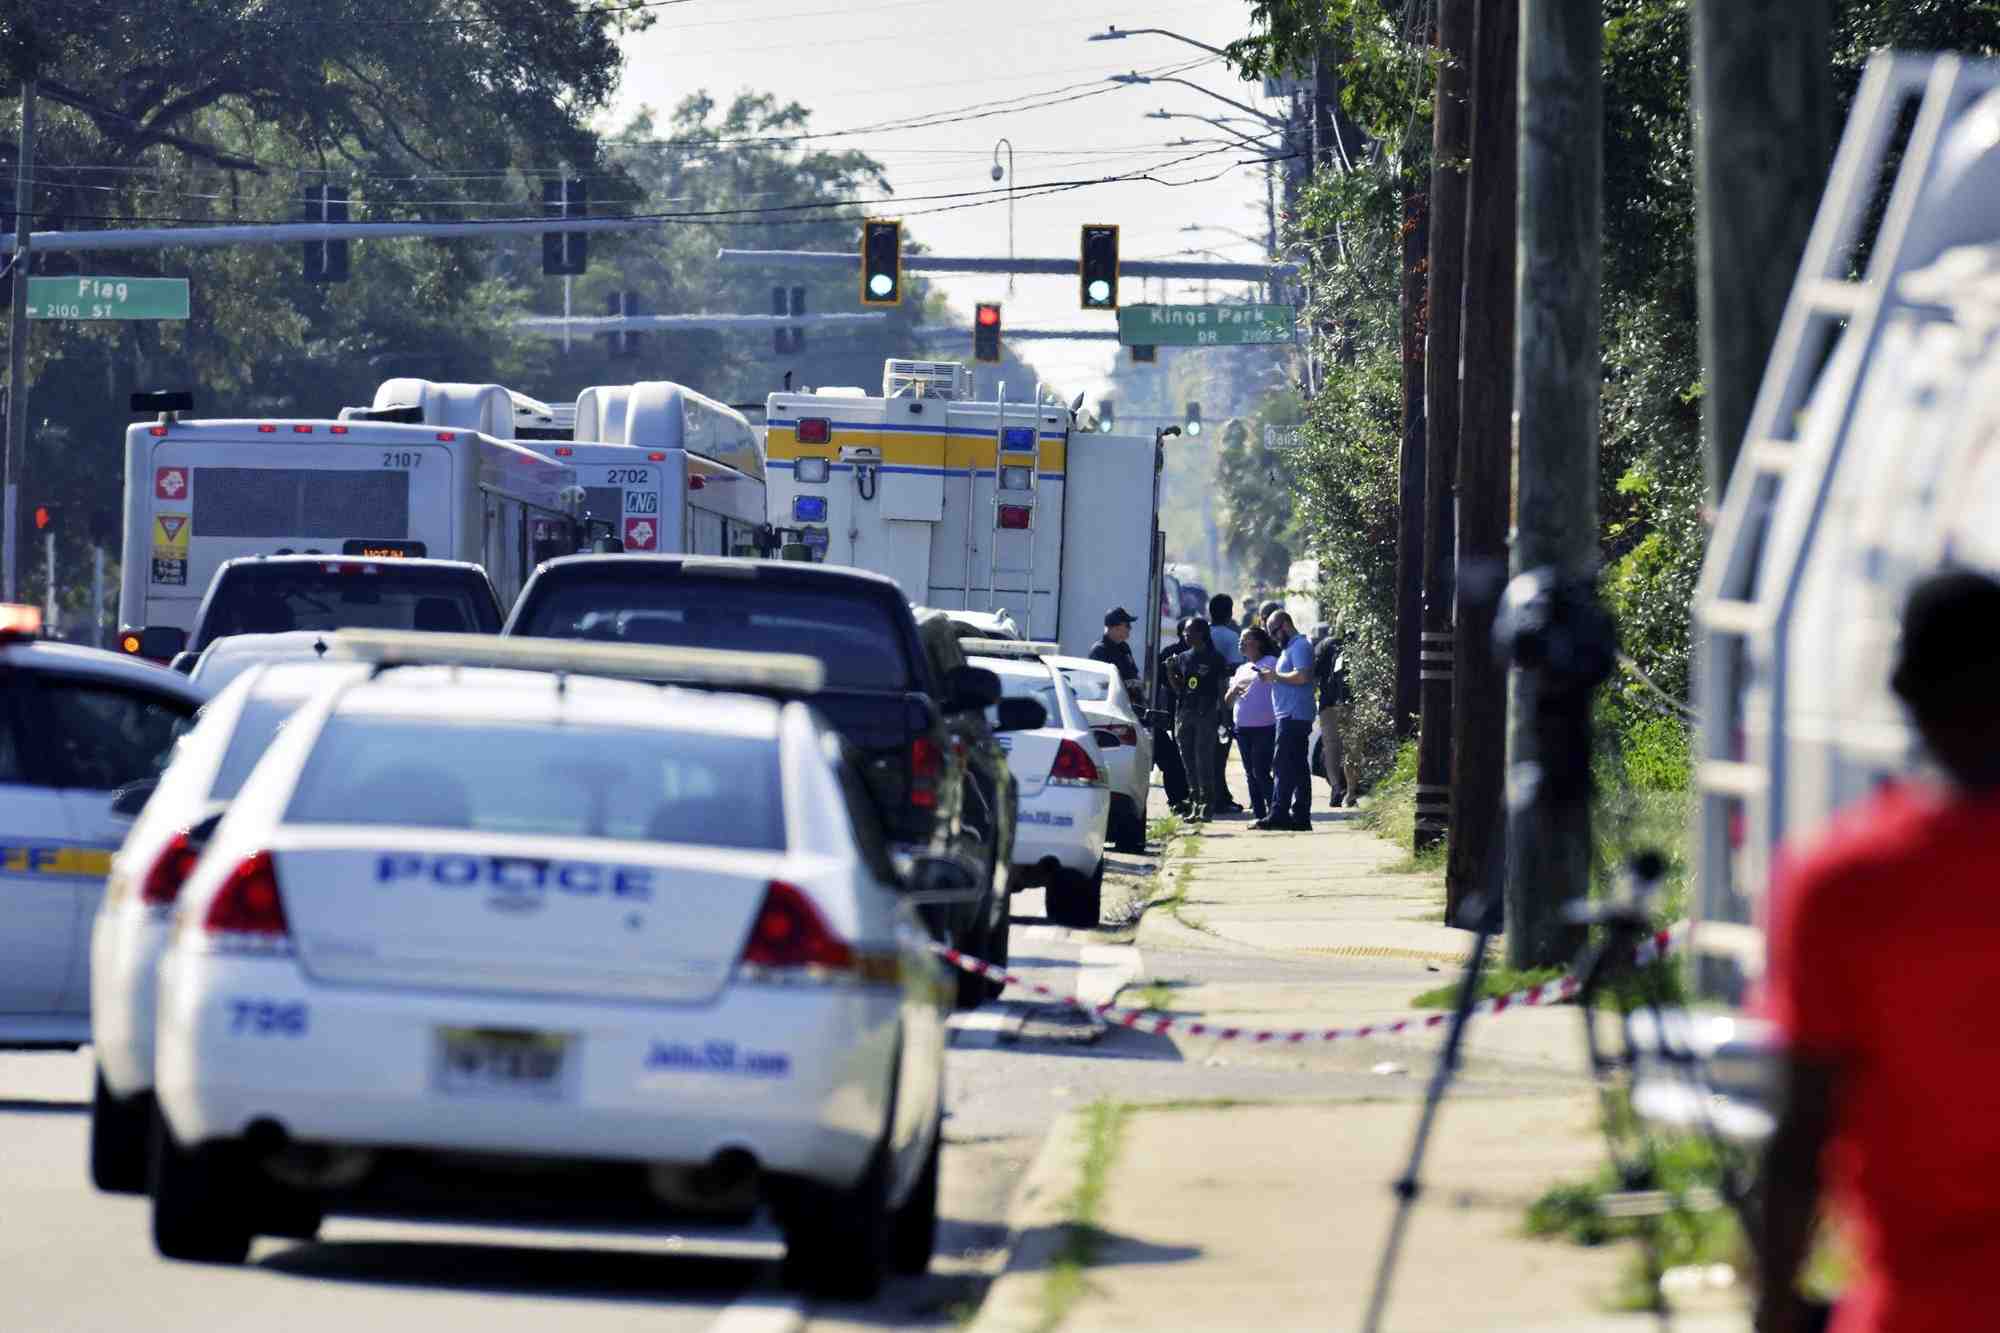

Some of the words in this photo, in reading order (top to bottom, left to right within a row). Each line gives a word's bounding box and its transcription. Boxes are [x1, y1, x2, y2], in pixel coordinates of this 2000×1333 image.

[78, 280, 129, 303] Flag
[47, 303, 80, 318] 2100
[92, 304, 113, 318] ST
[1151, 308, 1208, 327] Kings
[1217, 308, 1264, 324] Park
[1197, 330, 1217, 344] DR
[383, 451, 423, 468] 2107
[607, 470, 648, 484] 2702
[626, 491, 657, 512] CNG
[375, 853, 656, 900] POLICE
